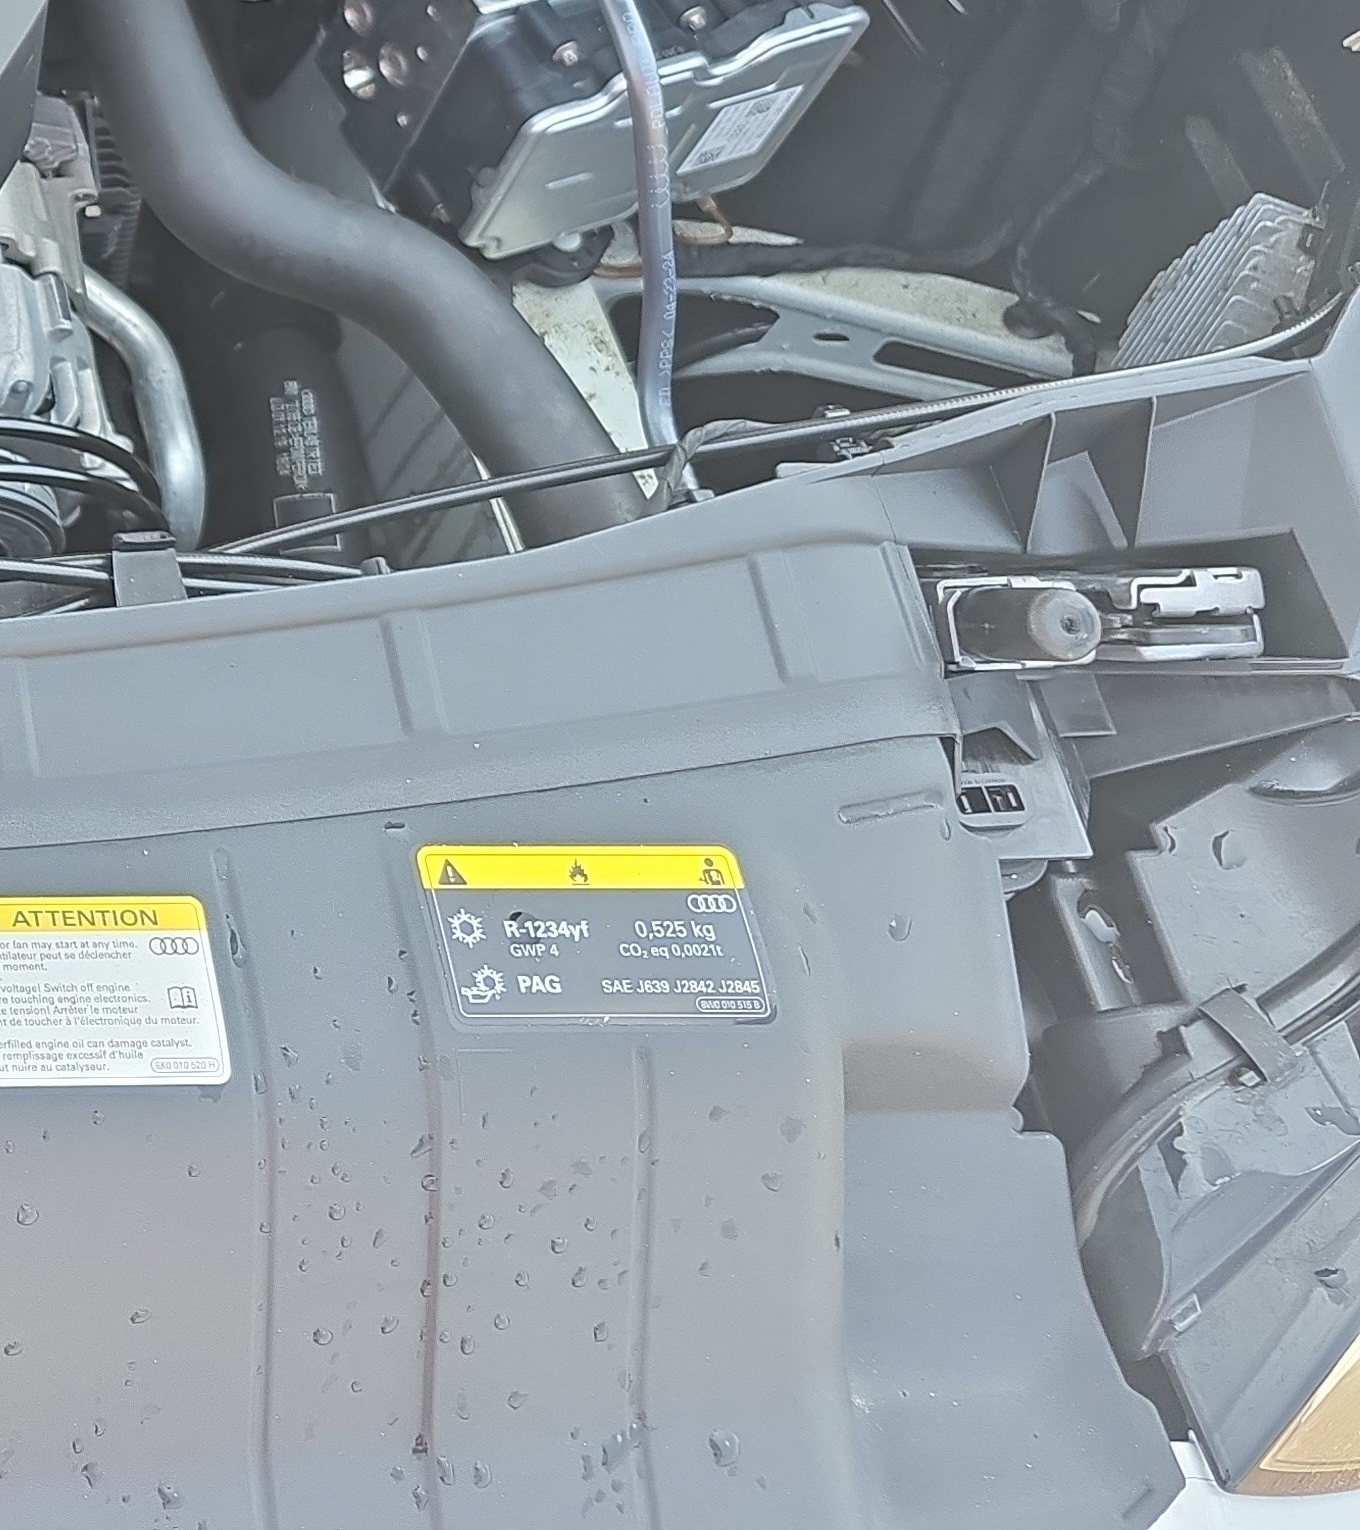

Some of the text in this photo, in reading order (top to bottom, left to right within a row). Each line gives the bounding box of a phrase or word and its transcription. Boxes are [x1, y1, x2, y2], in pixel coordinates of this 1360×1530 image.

[12, 908, 159, 927] ATTENTION
[503, 920, 589, 942] R-1234yf
[634, 921, 716, 942] 0,525 kg
[13, 940, 28, 949] fan
[31, 941, 52, 950] may
[55, 941, 78, 949] start
[80, 941, 91, 949] at
[92, 941, 110, 950] any
[112, 940, 138, 949] time.
[509, 944, 559, 957] GWP 4
[40, 951, 62, 962] peut
[79, 950, 132, 959] déclencher
[651, 946, 669, 959] eq
[671, 944, 723, 958] 0,0021t
[3, 963, 47, 971] moment.
[43, 983, 77, 993] Switch
[81, 983, 93, 992] off
[96, 983, 130, 993] engine
[517, 976, 563, 993] PAG
[601, 980, 760, 993] SAE J639 J2842 J2845
[11, 994, 55, 1006] touching
[57, 994, 91, 1005] engine
[94, 994, 151, 1003] electronics.
[91, 1005, 99, 1014] le
[9, 1017, 22, 1026] de
[24, 1017, 63, 1026] toucher
[66, 1016, 72, 1025] à
[74, 1016, 142, 1027] l'électronique
[145, 1016, 158, 1025] du
[161, 1016, 199, 1025] moteur.
[35, 1039, 69, 1050] engine
[72, 1038, 84, 1048] oil
[87, 1040, 105, 1048] can
[107, 1039, 148, 1049] damage
[151, 1038, 192, 1049] catalyst.
[3, 1051, 63, 1063] remplissage
[66, 1050, 106, 1060] excessif
[109, 1050, 144, 1059] d'huile
[12, 1063, 37, 1071] nuire
[55, 1062, 110, 1073] catalyseur.
